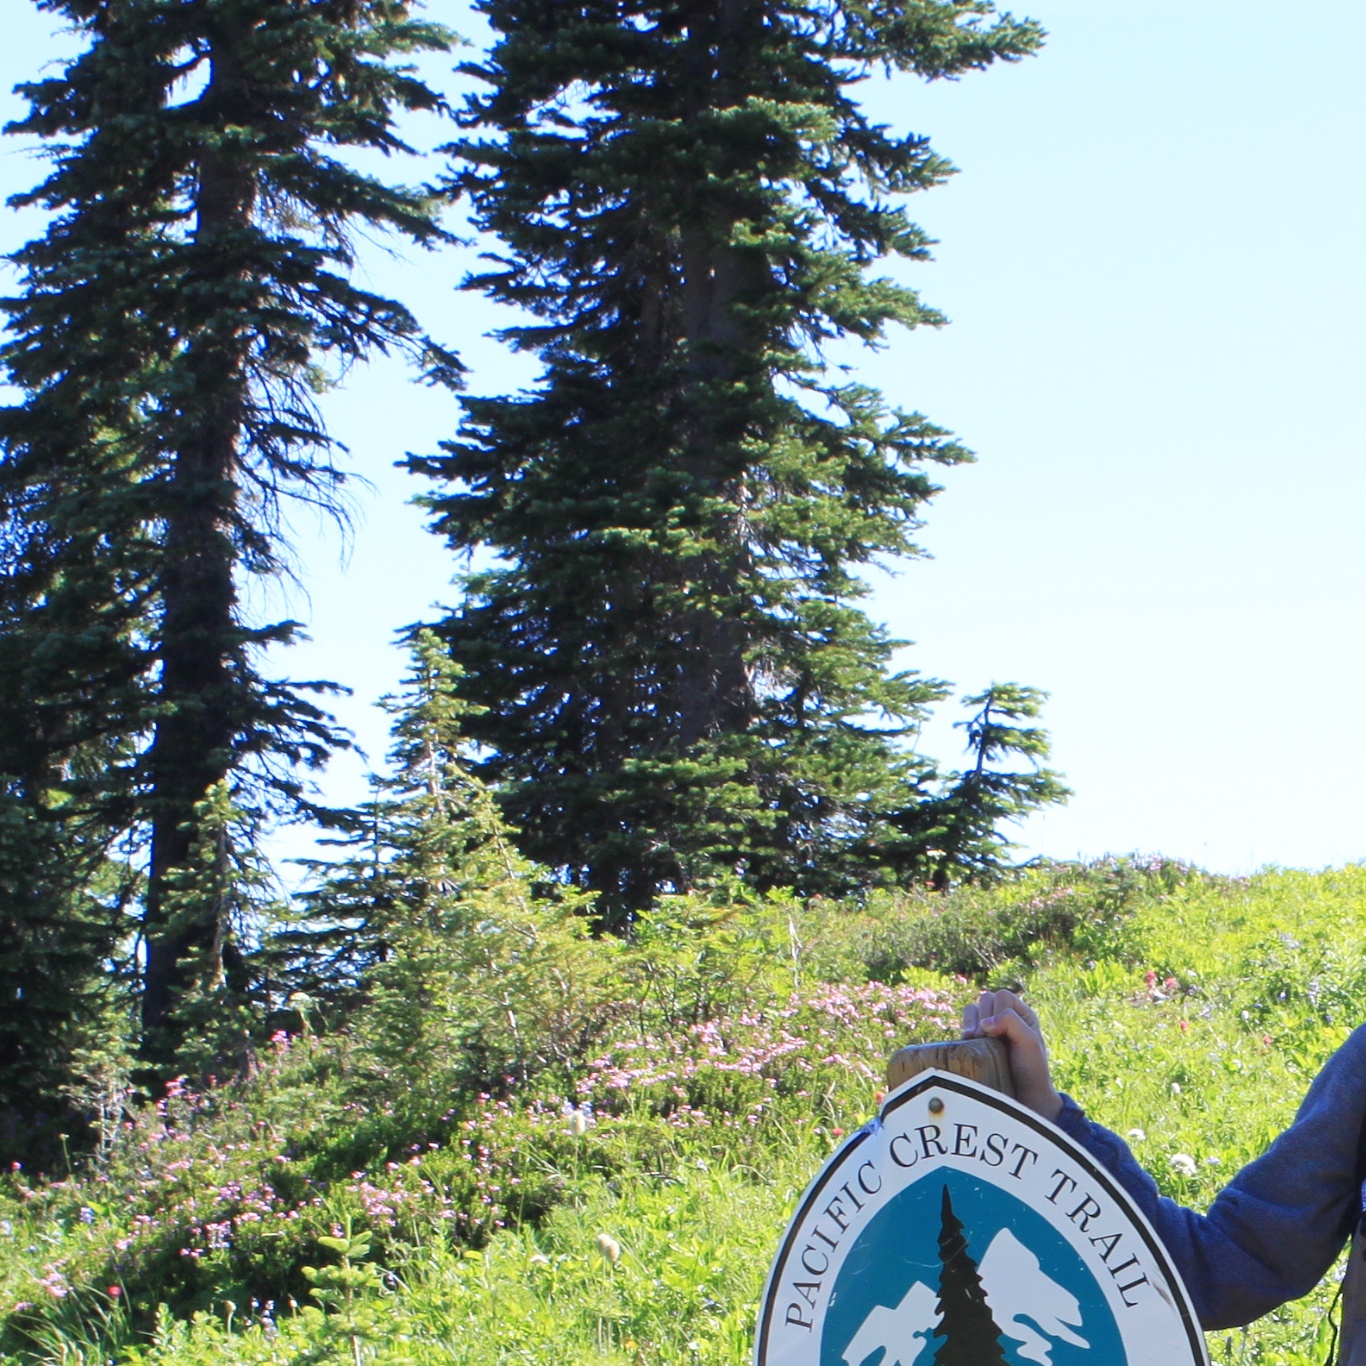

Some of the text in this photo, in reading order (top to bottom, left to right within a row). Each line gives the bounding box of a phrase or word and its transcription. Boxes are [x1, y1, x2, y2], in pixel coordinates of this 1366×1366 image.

[785, 1123, 1151, 1333] PACIFIC CREST TRAIL
